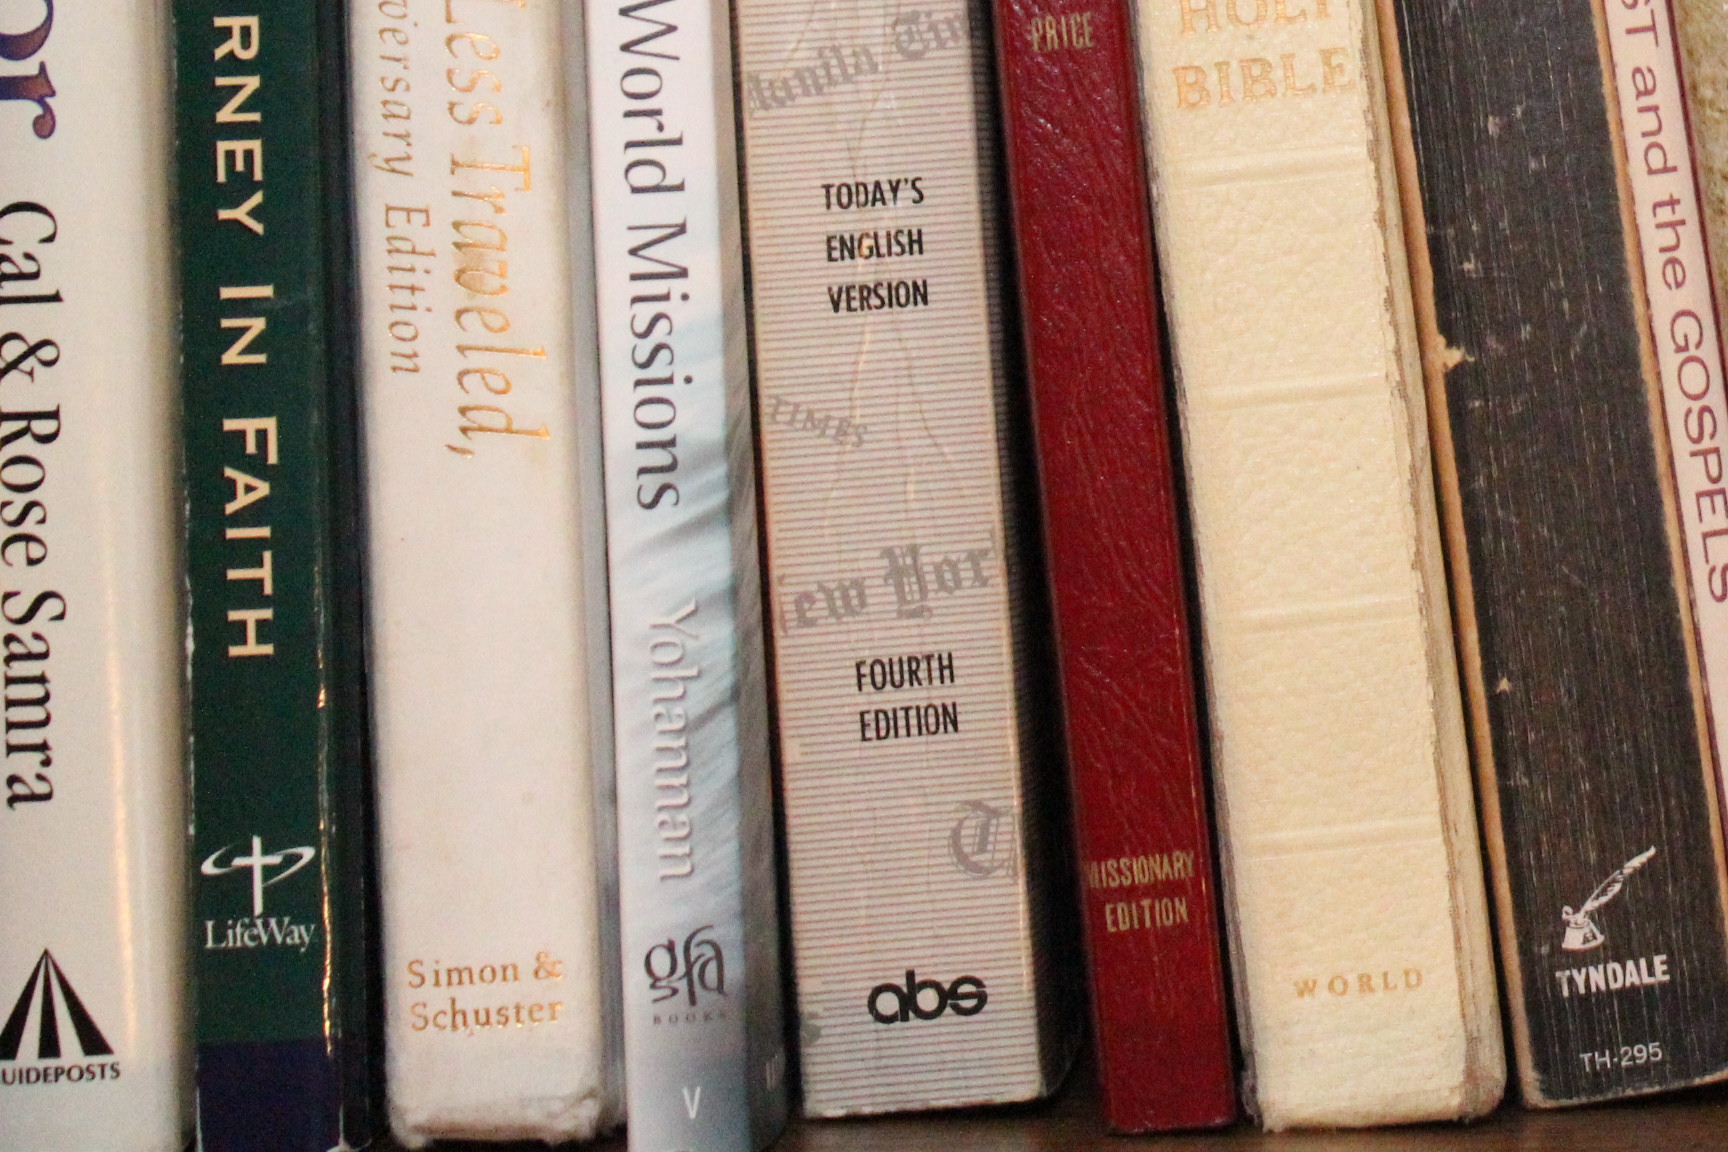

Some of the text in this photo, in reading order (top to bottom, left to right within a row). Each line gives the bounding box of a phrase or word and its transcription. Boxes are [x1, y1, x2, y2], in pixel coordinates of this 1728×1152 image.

[1030, 11, 1096, 53] PRICE
[1173, 46, 1356, 111] BIBLE
[1631, 63, 1679, 176] and
[821, 176, 926, 211] TODAY'S
[825, 228, 925, 263] ENGLISH
[1652, 193, 1688, 291] the
[384, 202, 437, 376] Edition
[826, 279, 930, 314] VERSION
[219, 284, 274, 366] IN
[625, 215, 694, 512] Missions
[0, 199, 67, 810] Cal & Rose Samra
[222, 415, 279, 659] FAITH
[854, 651, 956, 693] FOURTH
[648, 597, 700, 883] Yohannan
[858, 701, 960, 743] EDITION
[204, 915, 316, 952] LifeWay
[1104, 896, 1189, 933] EDITION
[406, 950, 565, 990] Simon &
[1293, 966, 1424, 1000] WORLD
[1554, 953, 1672, 998] TYNDALE
[408, 997, 565, 1033] Schuster
[867, 970, 988, 1024] abs
[0, 1061, 122, 1086] UIDEPOSTS
[1578, 1042, 1664, 1075] TH-295
